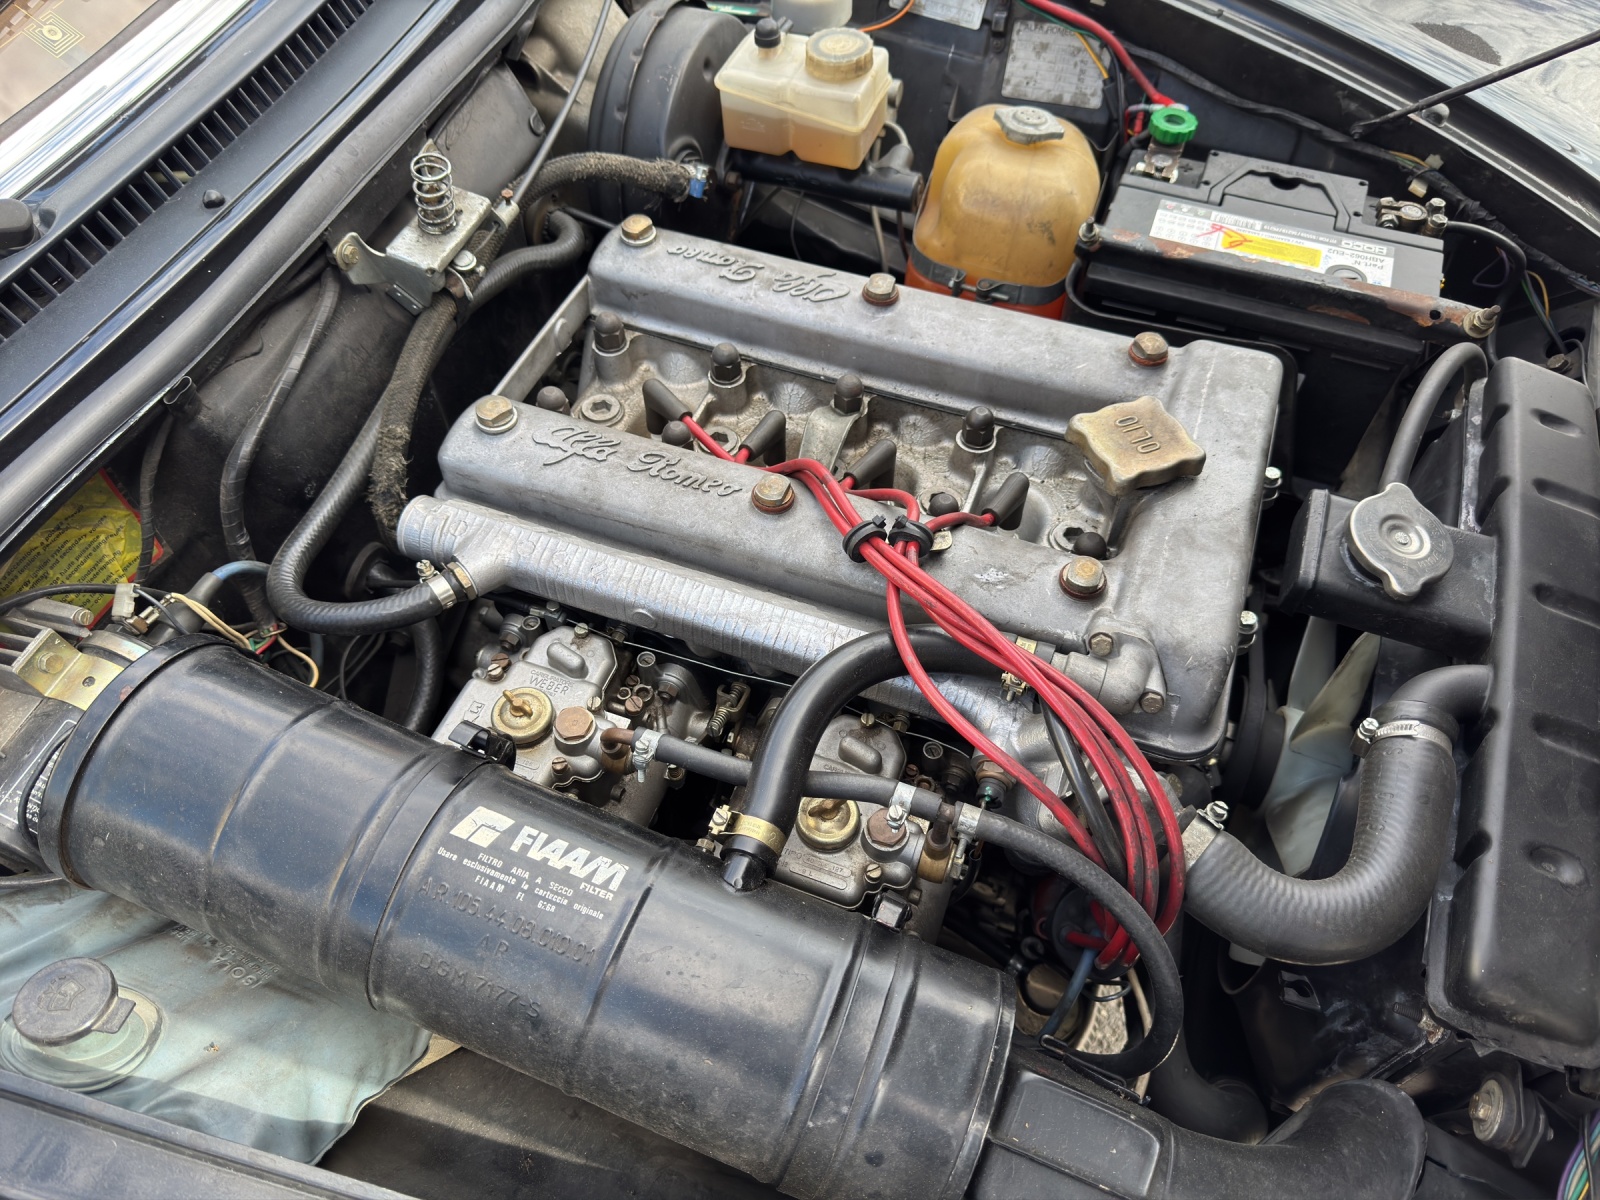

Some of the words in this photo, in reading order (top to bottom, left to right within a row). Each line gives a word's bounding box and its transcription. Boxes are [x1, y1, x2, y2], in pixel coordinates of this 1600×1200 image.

[532, 427, 622, 466] Alfa
[627, 452, 742, 496] Romeo
[530, 675, 569, 696] WEBER
[478, 852, 504, 868] FILTRO
[510, 866, 530, 879] ARIA
[535, 876, 542, 884] A
[550, 881, 574, 896] SECCO
[510, 826, 629, 892] FIAAM
[438, 846, 458, 862] Usare
[462, 856, 516, 886] esclusivamente
[573, 902, 604, 920] originale
[474, 874, 505, 893] FIAAM
[580, 882, 614, 901] FILTER
